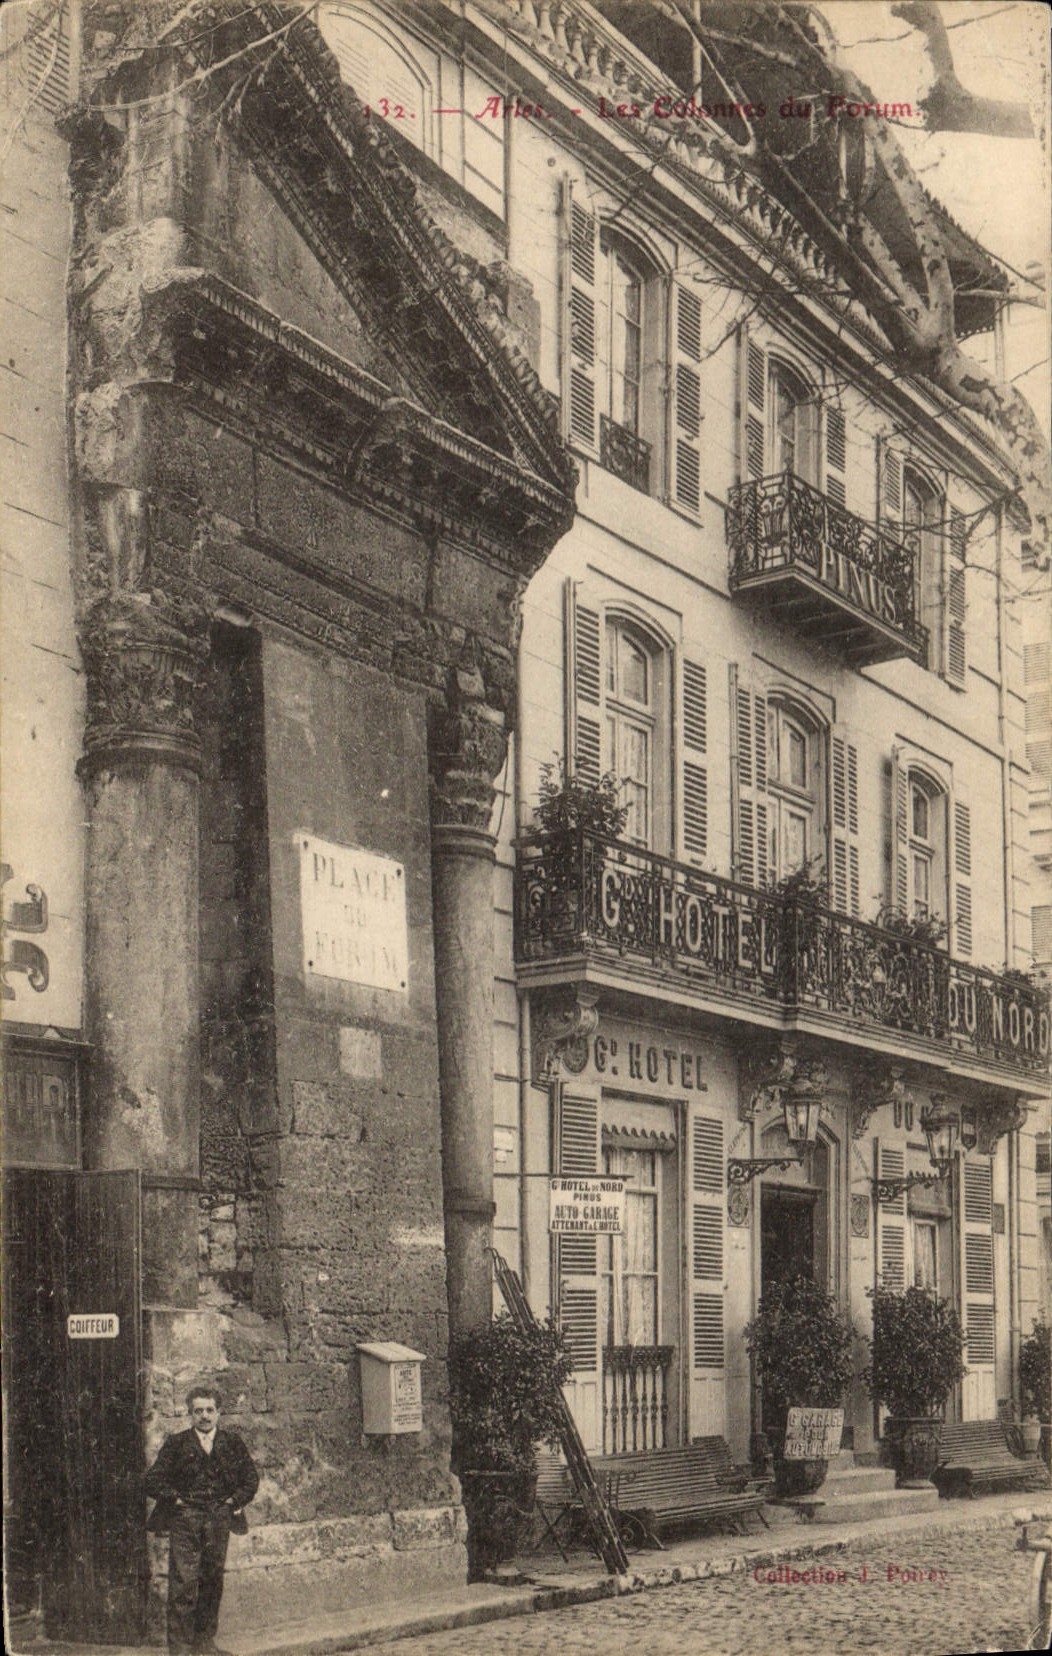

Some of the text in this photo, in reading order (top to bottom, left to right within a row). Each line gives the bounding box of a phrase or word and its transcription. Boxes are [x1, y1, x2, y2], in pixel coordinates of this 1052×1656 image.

[820, 540, 897, 626] PINUS
[660, 886, 776, 975] HOTEL
[949, 982, 976, 1033] DU
[992, 992, 1049, 1058] NORD
[629, 1041, 709, 1093] HOTEL
[561, 1180, 591, 1192] HOTEL
[600, 1182, 624, 1193] NORD
[573, 1192, 602, 1202] PINUS
[583, 1205, 620, 1220] GARAGE
[551, 1220, 588, 1231] ATTENANT
[69, 1318, 115, 1334] COIFFEUR
[800, 1412, 843, 1428] GARAGE
